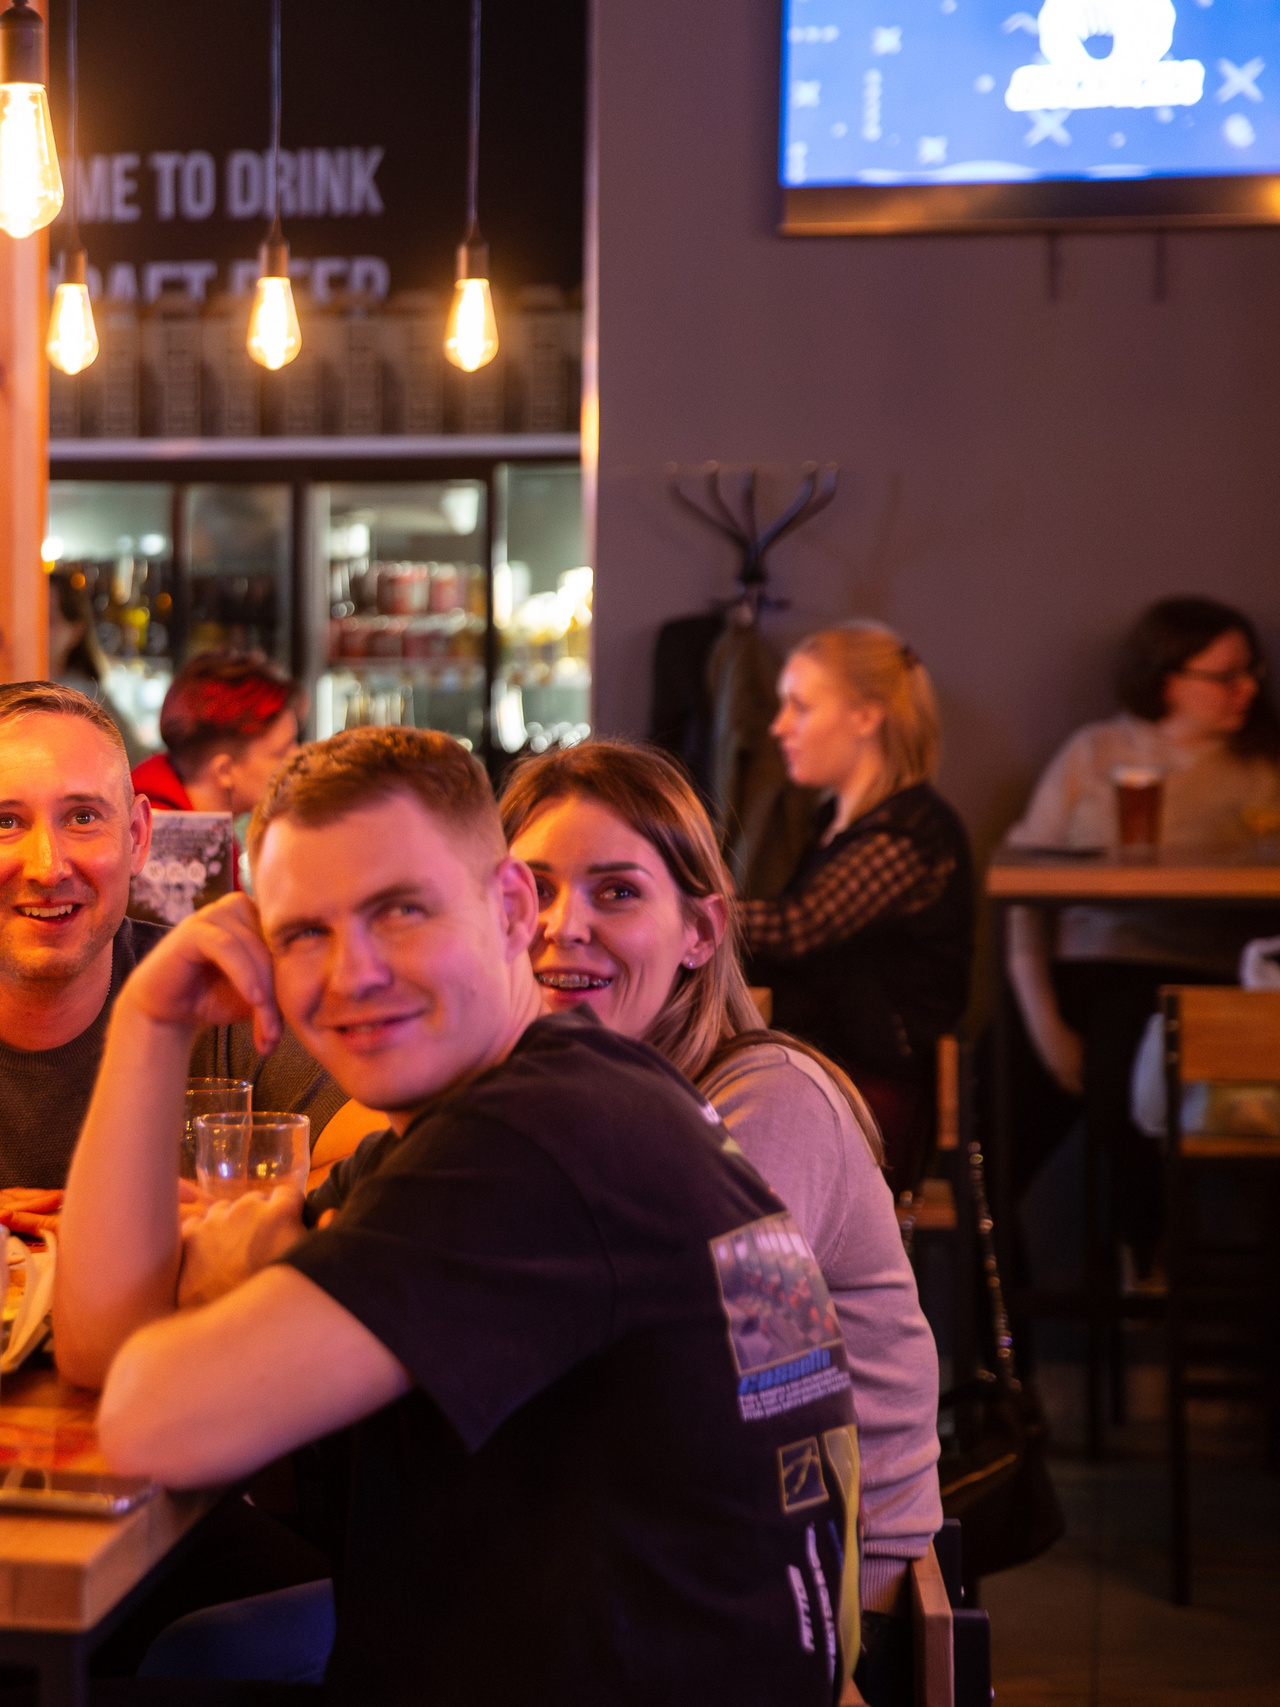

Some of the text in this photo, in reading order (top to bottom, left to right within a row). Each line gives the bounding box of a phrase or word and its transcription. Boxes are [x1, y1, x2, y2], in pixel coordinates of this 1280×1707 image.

[63, 146, 387, 224] ME TO DRINK
